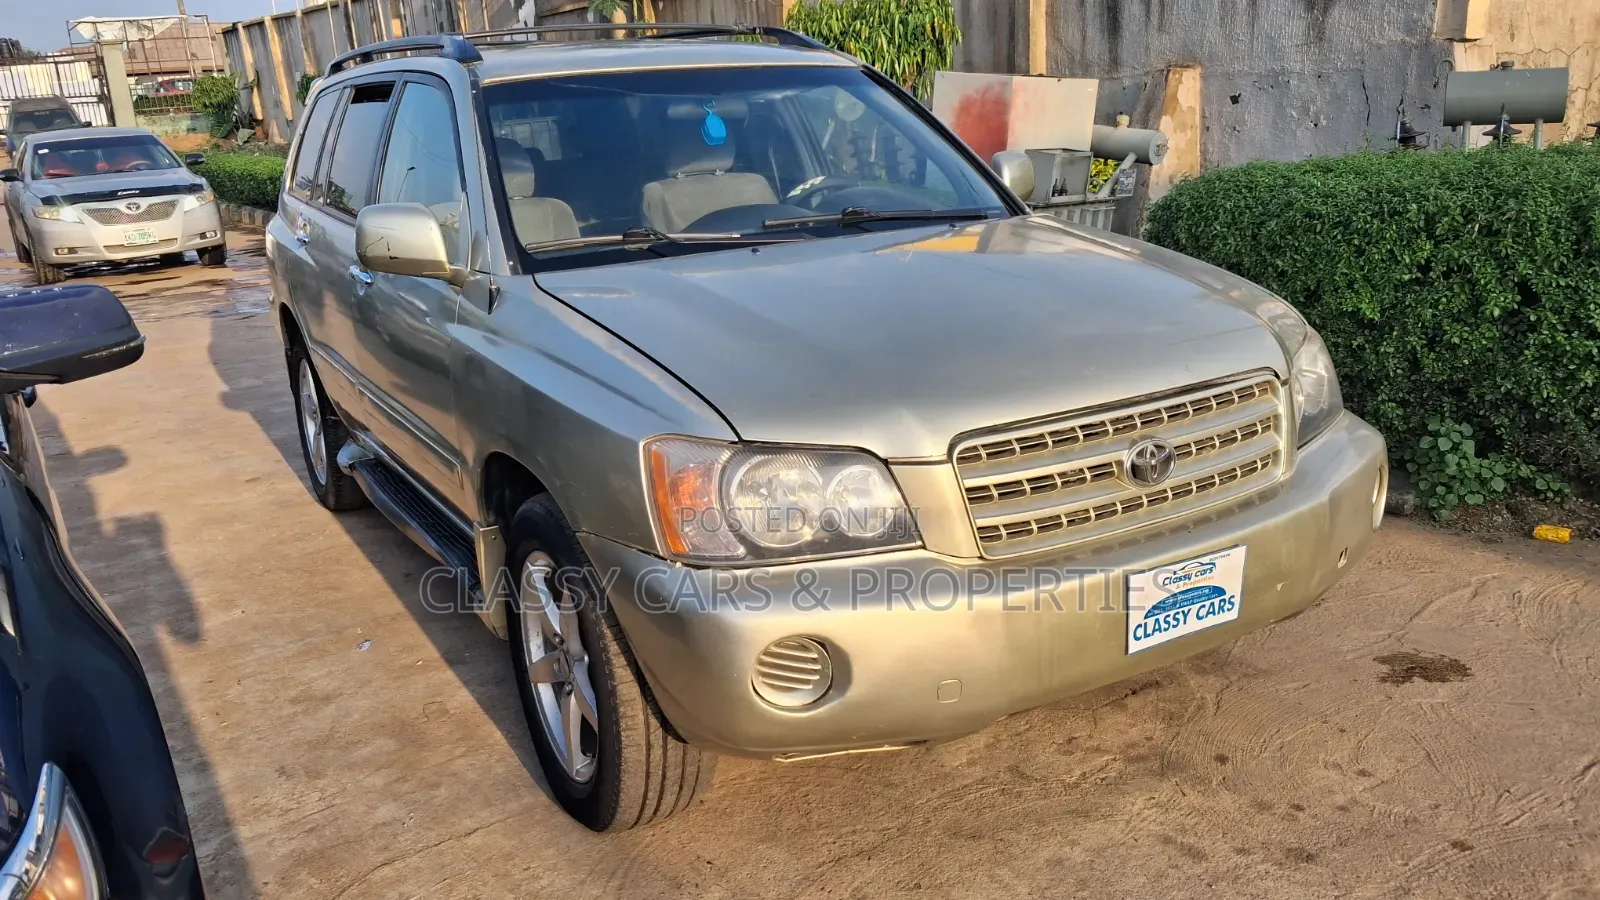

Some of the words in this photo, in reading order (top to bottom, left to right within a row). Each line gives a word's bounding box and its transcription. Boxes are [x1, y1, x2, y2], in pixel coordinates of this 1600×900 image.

[1162, 572, 1193, 587] Classy
[1194, 566, 1214, 578] cars
[1182, 575, 1214, 588] Properties
[1133, 608, 1192, 641] CLASSY
[1195, 595, 1236, 621] CARS
